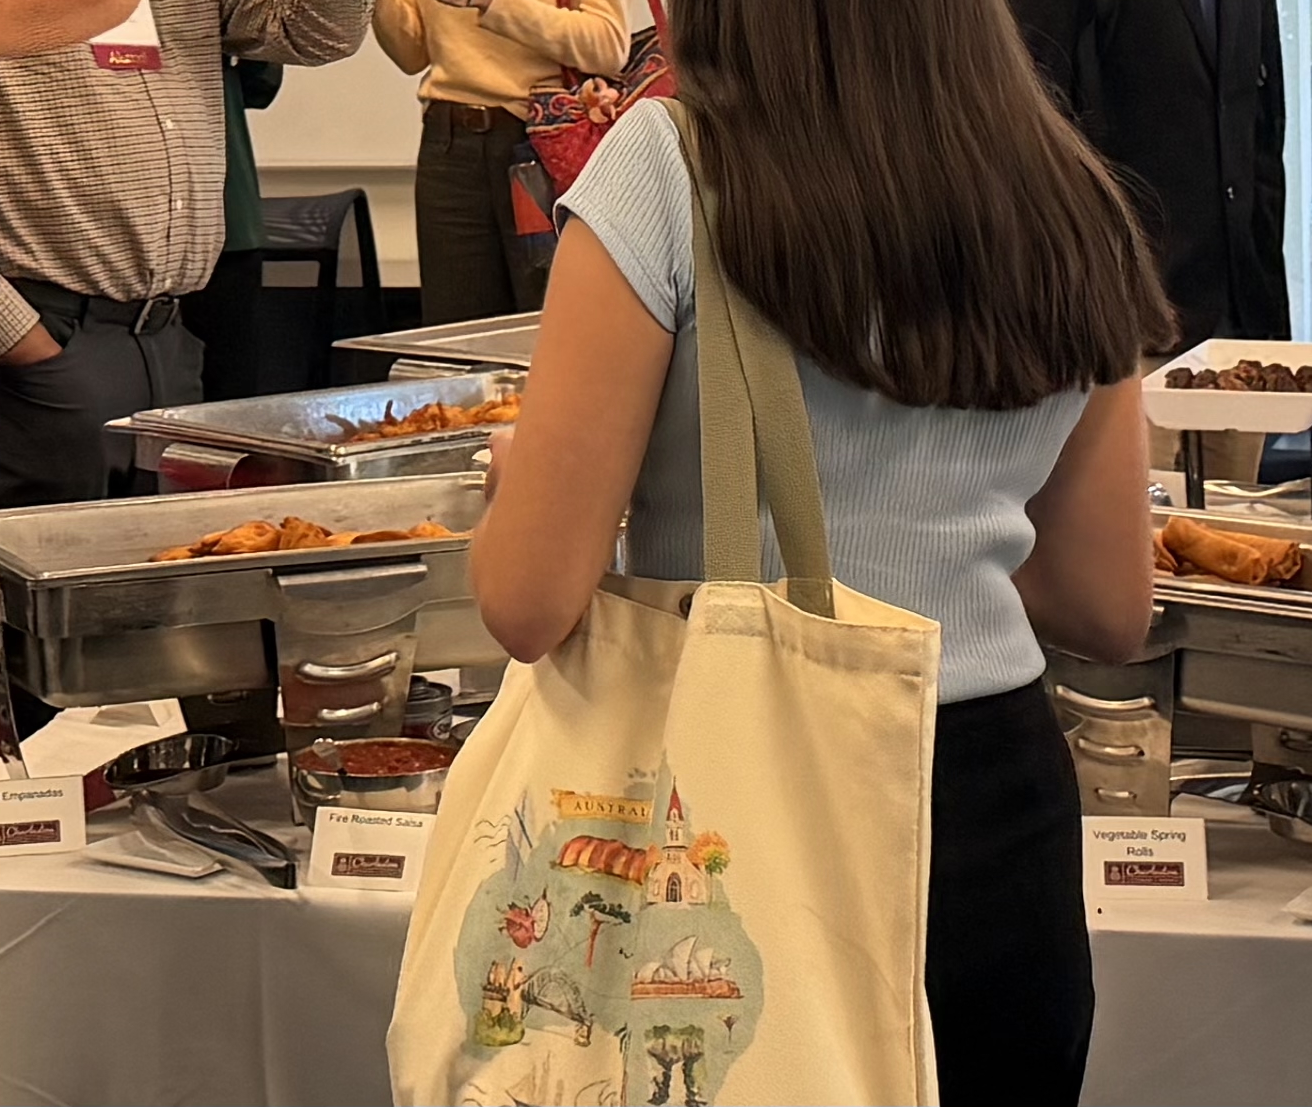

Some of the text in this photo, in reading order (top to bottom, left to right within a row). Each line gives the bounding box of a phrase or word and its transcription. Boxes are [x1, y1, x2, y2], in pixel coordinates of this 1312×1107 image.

[1, 789, 64, 802] Empanadas
[573, 799, 650, 818] AUSTRAL
[329, 812, 423, 828] Fire Roasted Salsa
[1092, 829, 1187, 843] Vegetable Spring
[1126, 846, 1155, 857] Rolls
